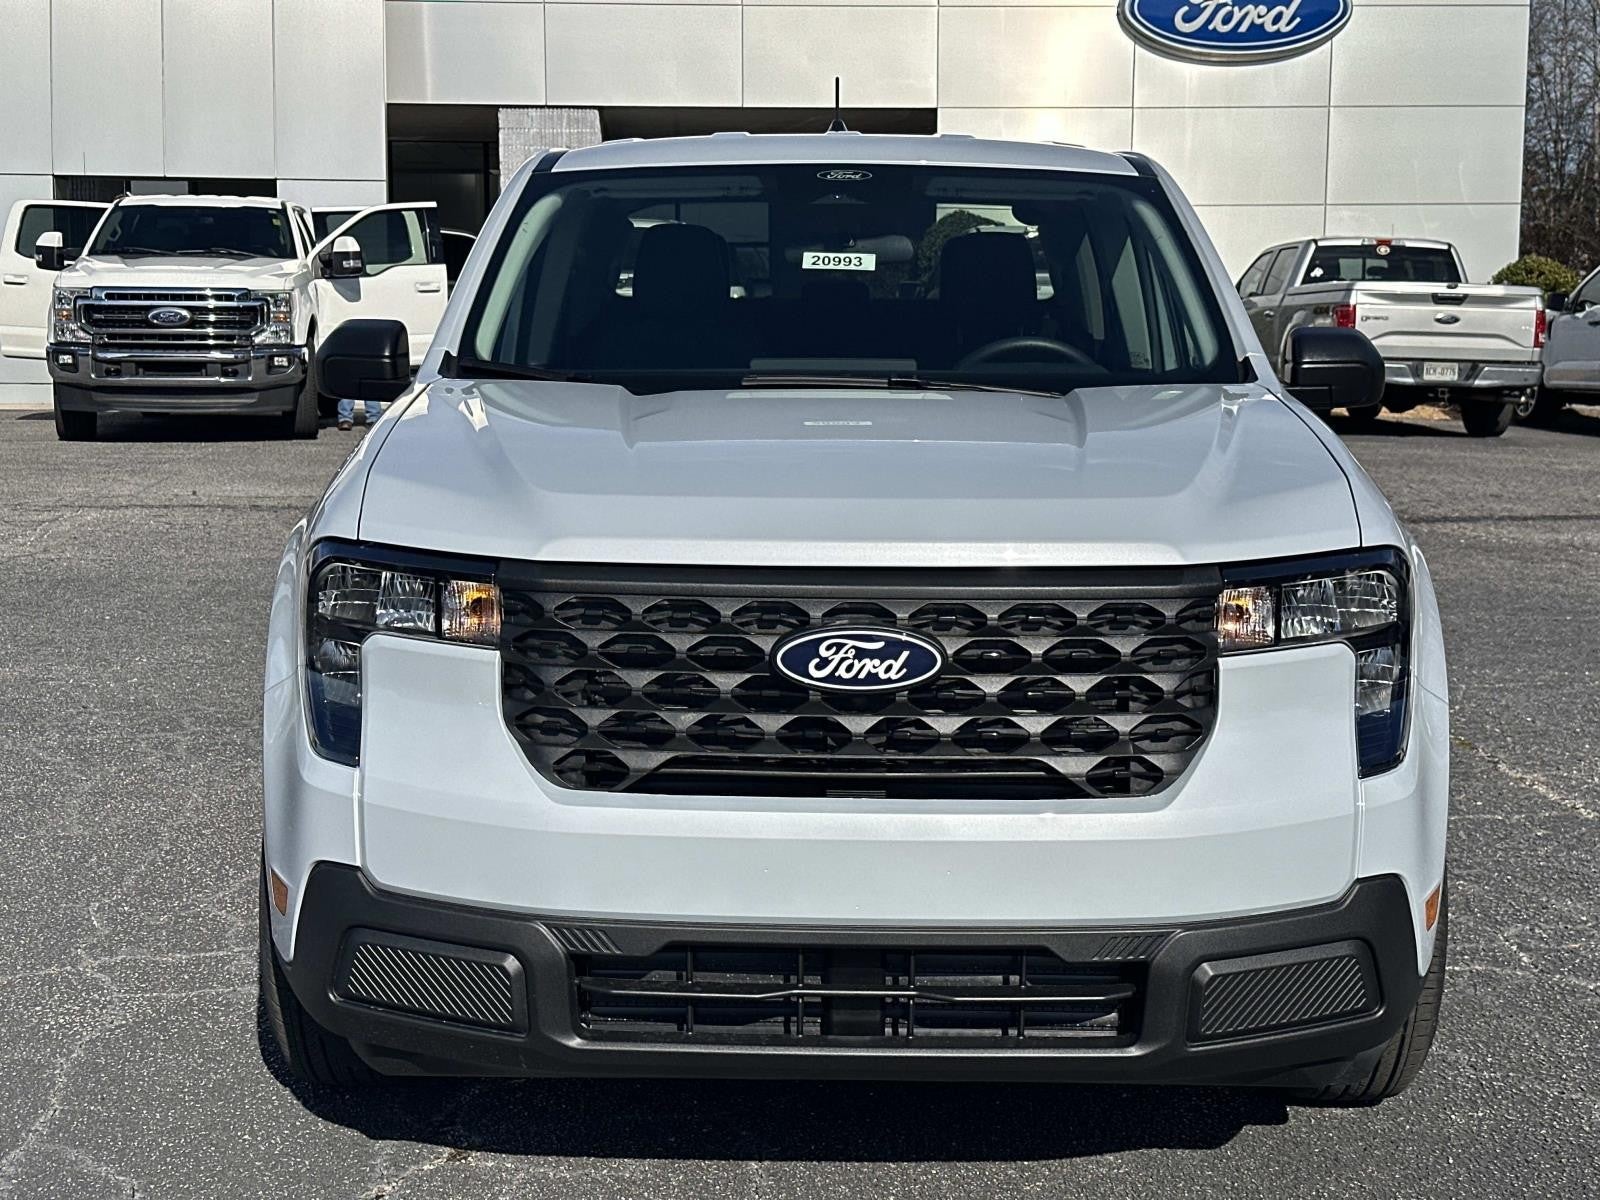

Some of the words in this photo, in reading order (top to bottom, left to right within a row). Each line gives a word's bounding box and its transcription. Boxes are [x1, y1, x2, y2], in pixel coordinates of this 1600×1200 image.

[827, 171, 862, 179] Ford
[811, 255, 863, 267] 20993
[808, 639, 910, 680] Ford
